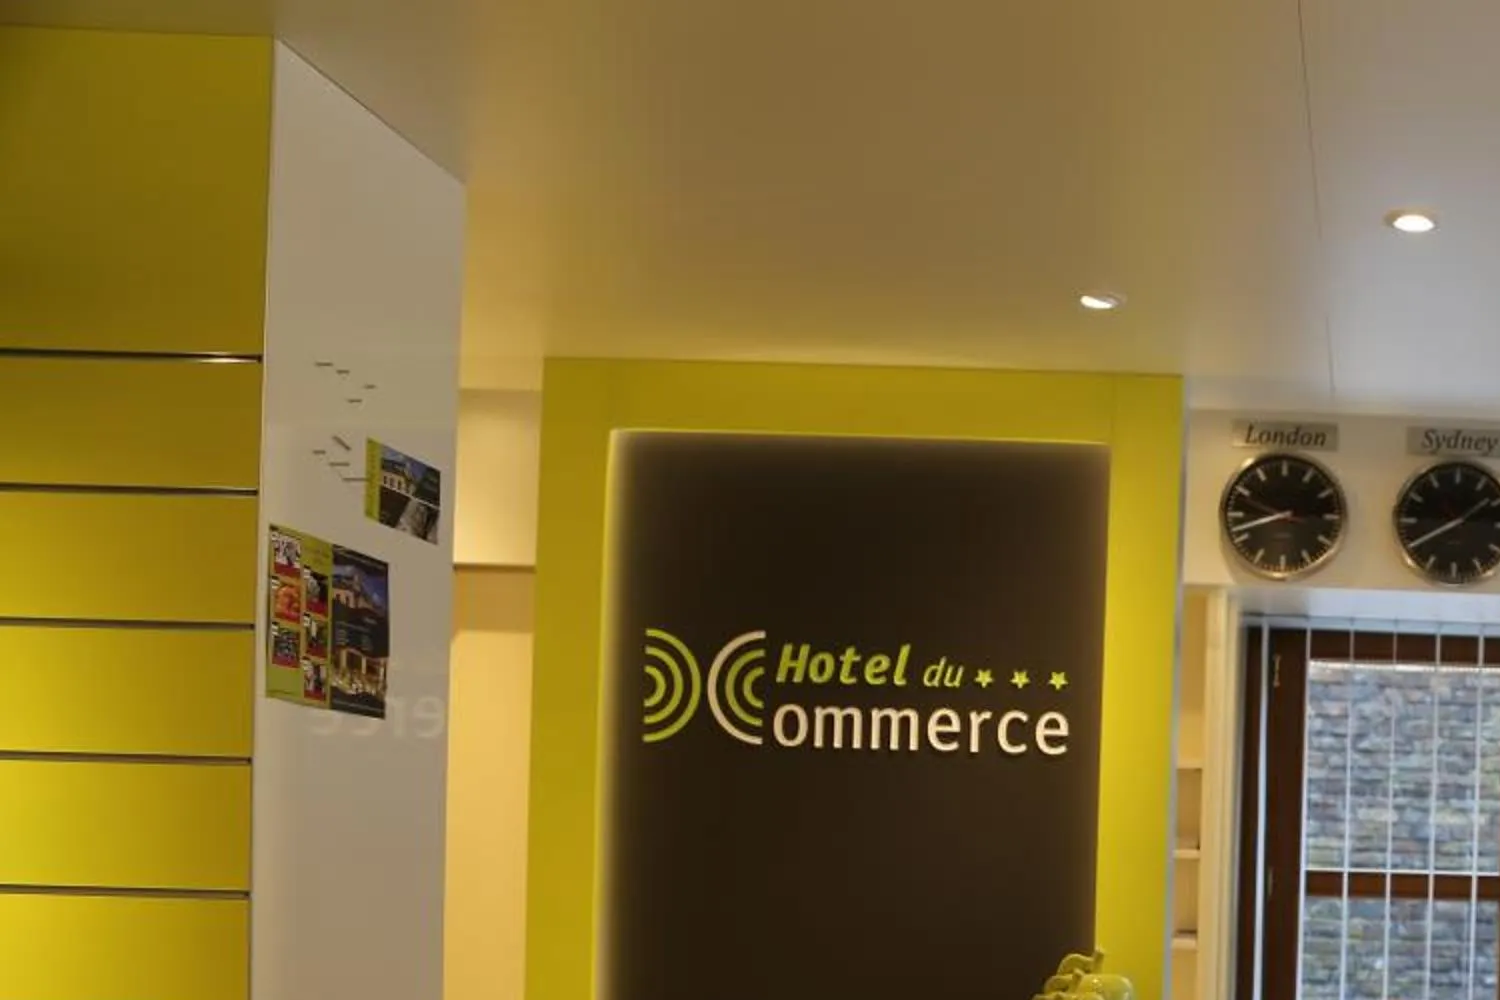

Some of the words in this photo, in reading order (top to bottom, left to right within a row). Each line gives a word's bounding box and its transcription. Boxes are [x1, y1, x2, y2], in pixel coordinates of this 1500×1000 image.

[1245, 424, 1327, 447] London
[1421, 428, 1499, 453] Sydney
[775, 643, 911, 687] Hotel
[922, 656, 965, 688] du
